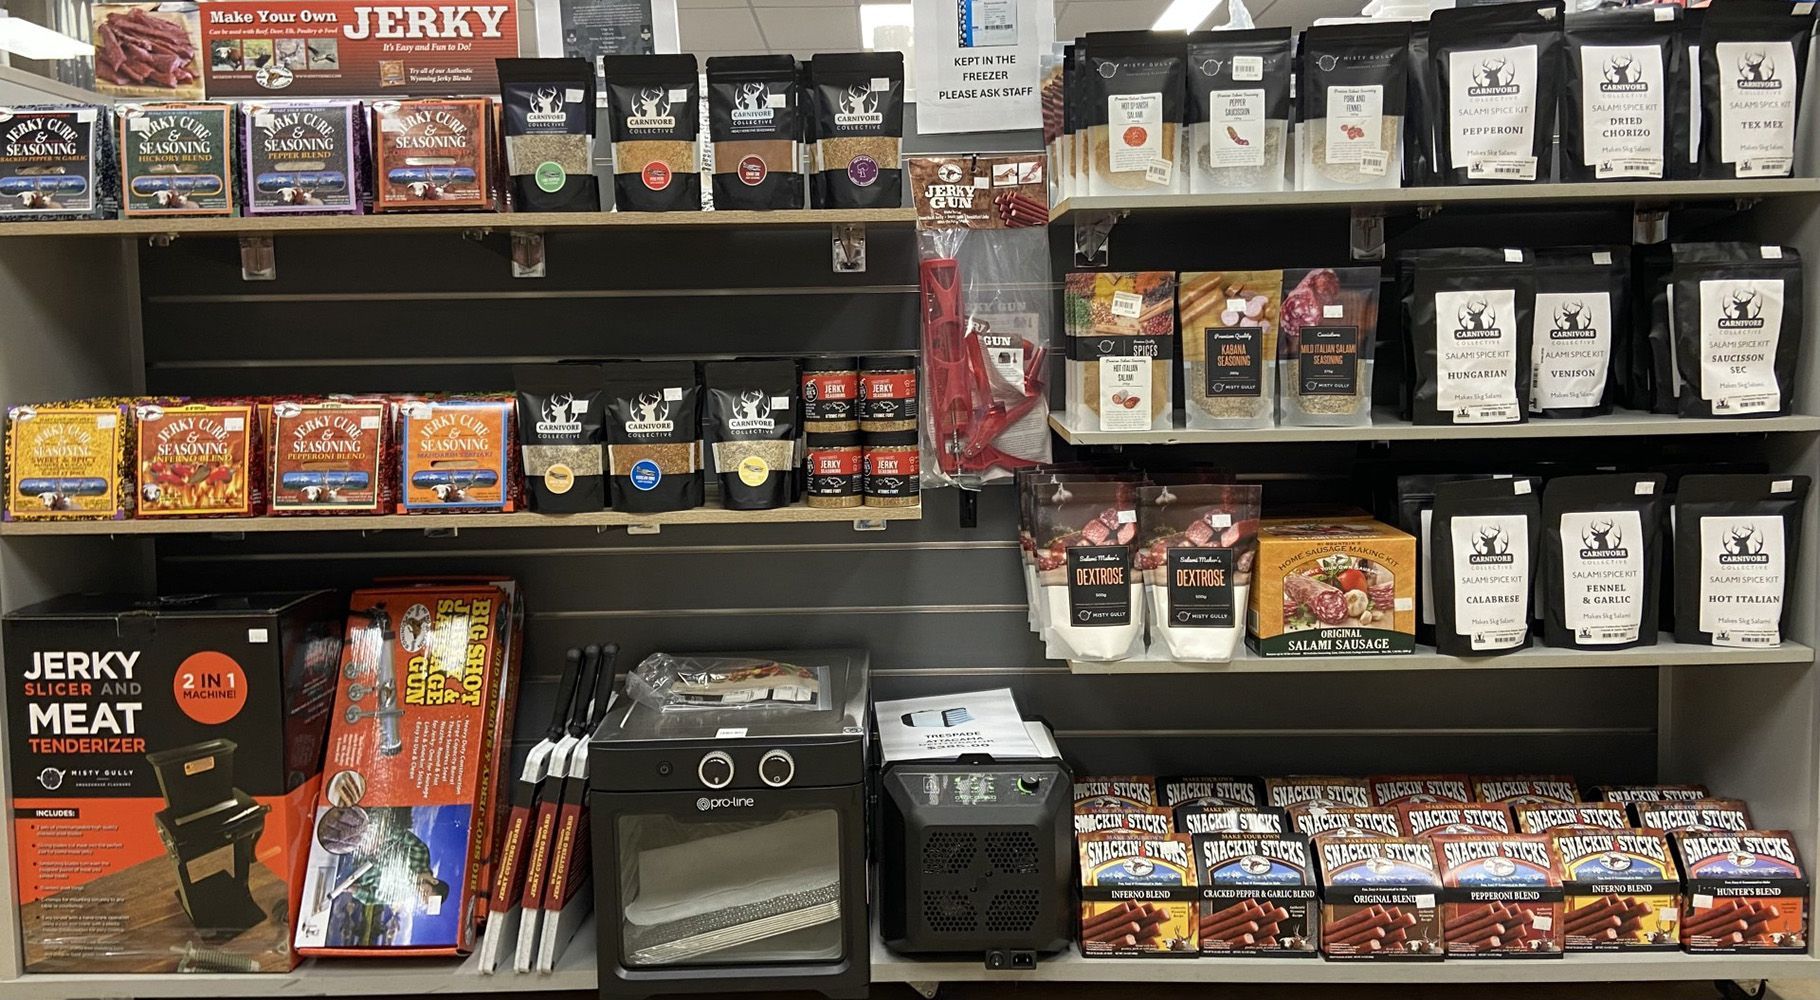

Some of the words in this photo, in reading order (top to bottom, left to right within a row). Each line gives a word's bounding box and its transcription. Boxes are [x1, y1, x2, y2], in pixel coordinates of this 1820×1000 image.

[210, 10, 253, 25] Make
[256, 11, 297, 24] Your
[300, 9, 338, 23] Own
[343, 5, 508, 40] JERKY
[383, 43, 394, 52] It's
[395, 43, 414, 53] Easy
[415, 43, 430, 52] and
[431, 43, 447, 51] Fun
[448, 43, 456, 52] to
[457, 42, 472, 51] Do!
[954, 57, 980, 66] KEPT
[982, 56, 993, 65] IN
[996, 55, 1016, 64] THE
[410, 75, 436, 83] Wyoming
[962, 71, 1008, 81] FREEZER
[1602, 82, 1647, 91] CARNIVORE
[1739, 80, 1781, 88] CARNIVORE
[939, 89, 978, 100] PLEASE
[980, 88, 1000, 98] ASK
[1002, 87, 1033, 97] STAFF
[1469, 86, 1519, 95] CARNIVORE
[733, 110, 772, 118] CARNIVORE
[303, 112, 335, 138] CURE
[629, 118, 674, 126] CARNIVORE
[1610, 117, 1643, 125] DRIED
[1740, 121, 1761, 129] TEX
[1763, 120, 1784, 129] MEX
[180, 116, 212, 142] CURE
[1463, 126, 1524, 136] PEPPERONI
[1602, 129, 1651, 138] CHORIZO
[139, 140, 211, 155] SEASONING
[264, 137, 334, 151] SEASONING
[138, 155, 179, 163] HICKORY
[181, 154, 213, 162] BLEND
[268, 151, 300, 160] PEPPER
[301, 151, 331, 159] BLEND
[925, 184, 975, 198] JERKY
[930, 197, 973, 209] GUN
[1456, 330, 1500, 338] CARNIVORE
[1552, 330, 1595, 338] CARNIVORE
[1133, 344, 1158, 357] SPICES
[1221, 344, 1247, 355] KABANA
[1446, 351, 1475, 359] SALAMI
[1499, 350, 1510, 358] KIT
[1217, 356, 1251, 367] SEASONING
[1712, 354, 1765, 363] SAUCISSON
[1447, 370, 1508, 380] HUNGARIAN
[1551, 369, 1596, 378] VENISON
[1730, 366, 1747, 374] SEC
[825, 384, 846, 394] JERKY
[294, 415, 331, 441] JERKY
[333, 415, 363, 441] CURE
[731, 420, 773, 428] CARNIVORE
[157, 417, 197, 443] JERKY
[158, 442, 228, 455] SEASONING
[293, 440, 361, 453] SEASONING
[153, 454, 197, 463] INFERNO
[199, 454, 232, 462] BLEND
[287, 452, 335, 461] PEPPERONI
[878, 459, 899, 469] JERKY
[1278, 552, 1303, 571] HOME
[1305, 545, 1347, 557] SAUSAGE
[1349, 546, 1386, 560] MAKING
[1386, 555, 1399, 568] KIT
[1471, 555, 1513, 563] CARNIVORE
[1582, 550, 1626, 558] CARNIVORE
[1076, 567, 1124, 586] DEXTROSE
[1177, 569, 1225, 587] DEXTROSE
[1586, 584, 1626, 592] FENNEL
[1466, 595, 1520, 604] CALABRESE
[1594, 596, 1631, 604] GARLIC
[1709, 595, 1733, 603] HOT
[1736, 595, 1780, 603] ITALIAN
[471, 599, 491, 640] BIG
[1321, 629, 1362, 638] ORIGINAL
[1288, 640, 1332, 651] SALAMI
[1335, 639, 1389, 650] SAUSAGE
[24, 651, 141, 680] JERKY
[462, 643, 486, 706] SHOT
[183, 674, 195, 689] 2
[201, 674, 222, 688] IN
[227, 674, 235, 687] 1
[405, 655, 427, 705] GUN
[24, 682, 92, 696] SLICER
[101, 683, 142, 695] AND
[183, 690, 237, 699] MACHINE!
[29, 702, 142, 735] MEAT
[29, 738, 146, 753] TENDERIZER
[711, 797, 754, 810] pro-line
[1204, 840, 1257, 867] SNACKIN'
[1261, 841, 1305, 867] STICKS
[1559, 835, 1614, 862] SNACKIN'
[1619, 836, 1666, 863] STICKS
[1683, 837, 1742, 865] SNACKIN'
[1746, 837, 1795, 864] STICKS
[499, 876, 508, 901] JERKY
[505, 845, 515, 875] CUTTING
[512, 818, 522, 844] BOARD
[531, 873, 539, 897] JERKY
[536, 841, 545, 872] CUTTING
[542, 813, 551, 839] BOARD
[1088, 841, 1143, 868] SNACKIN'
[1324, 843, 1381, 870] SNACKIN'
[1385, 843, 1433, 870] STICKS
[1444, 842, 1501, 869] SNACKIN'
[1504, 842, 1550, 869] STICKS
[1112, 890, 1144, 898] INFERNO
[1146, 890, 1170, 898] BLEND
[1204, 889, 1235, 898] CRACKED
[1236, 890, 1260, 898] PEPPER
[1261, 890, 1266, 898] &
[1267, 890, 1291, 898] GARLIC
[1292, 889, 1315, 898] BLEND
[1592, 885, 1626, 893] INFERNO
[1628, 885, 1652, 893] BLEND
[1717, 887, 1754, 896] HUNTER'S
[1756, 888, 1781, 896] BLEND
[1354, 894, 1388, 903] ORIGINAL
[1389, 894, 1416, 903] BLEND
[1471, 891, 1512, 900] PEPPERONI
[1514, 891, 1539, 899] BLEND
